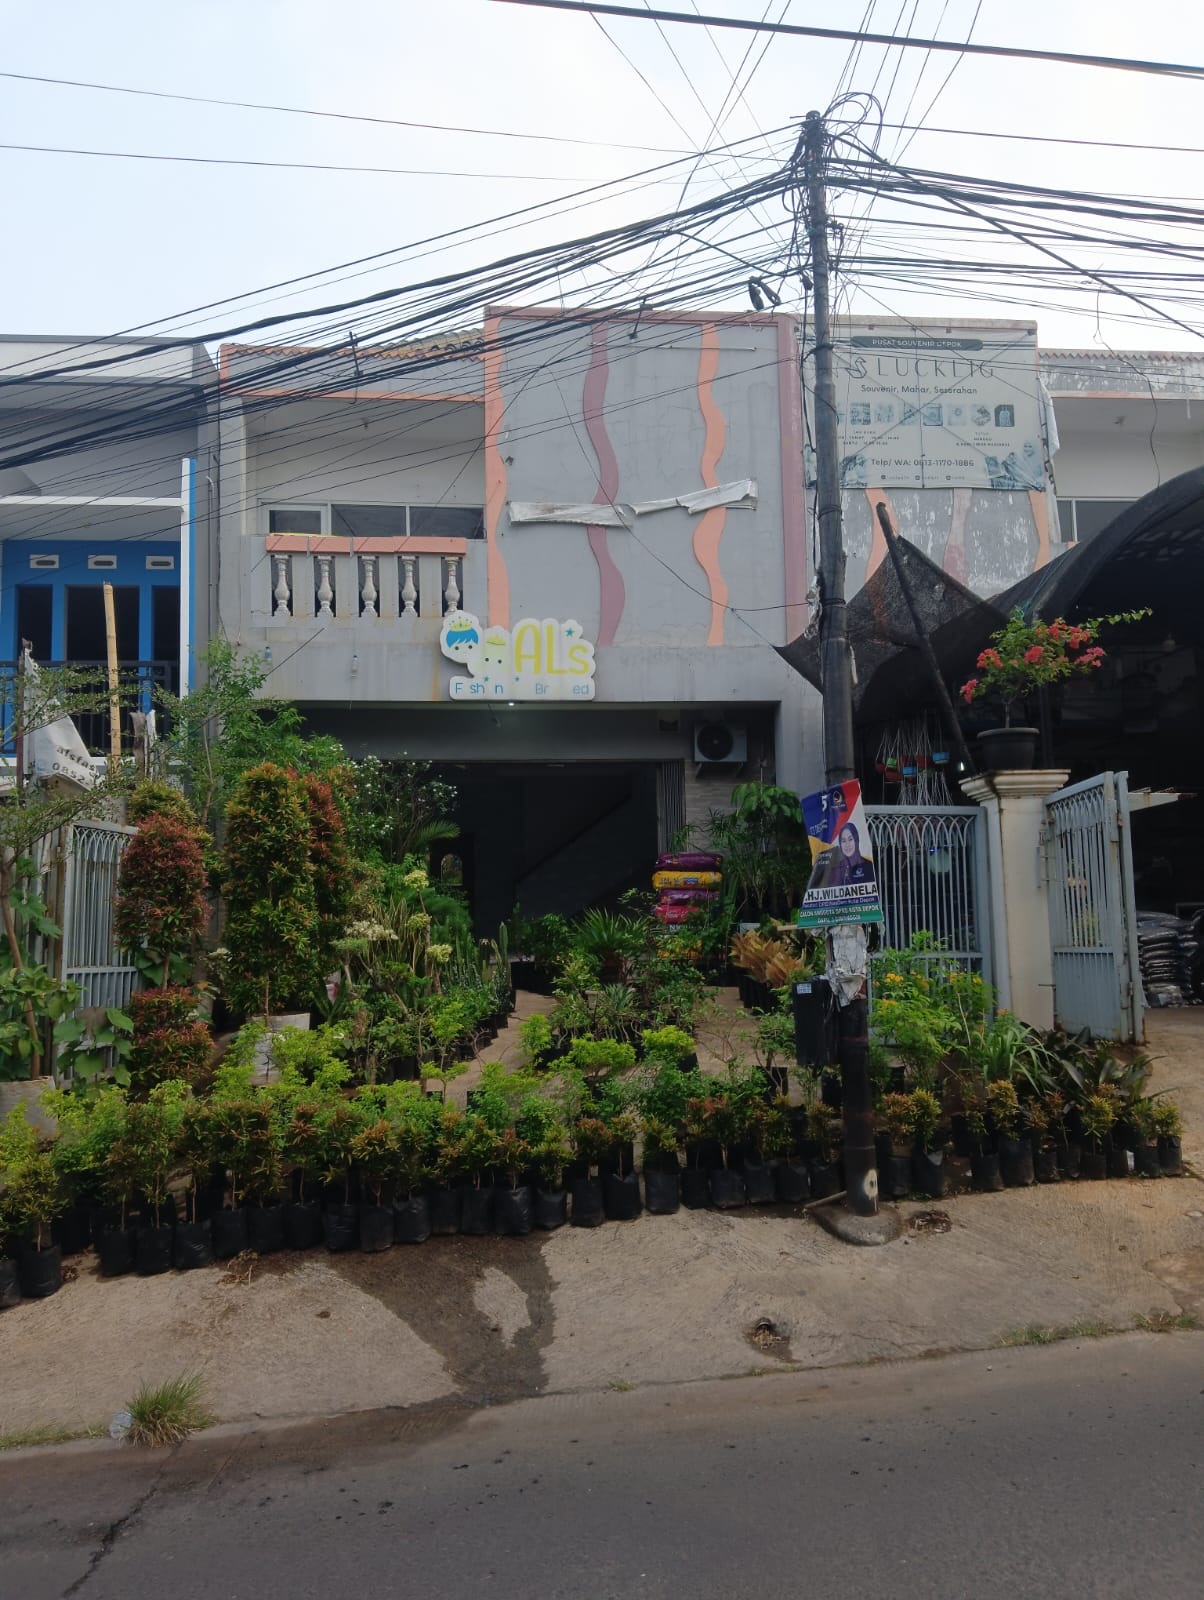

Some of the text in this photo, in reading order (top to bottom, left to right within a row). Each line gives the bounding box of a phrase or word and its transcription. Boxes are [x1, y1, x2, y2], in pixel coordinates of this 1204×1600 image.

[898, 340, 935, 348] SOUVENIR
[860, 384, 899, 394] Souvenir,
[901, 385, 932, 394] Mahar,
[821, 794, 828, 813] 5
